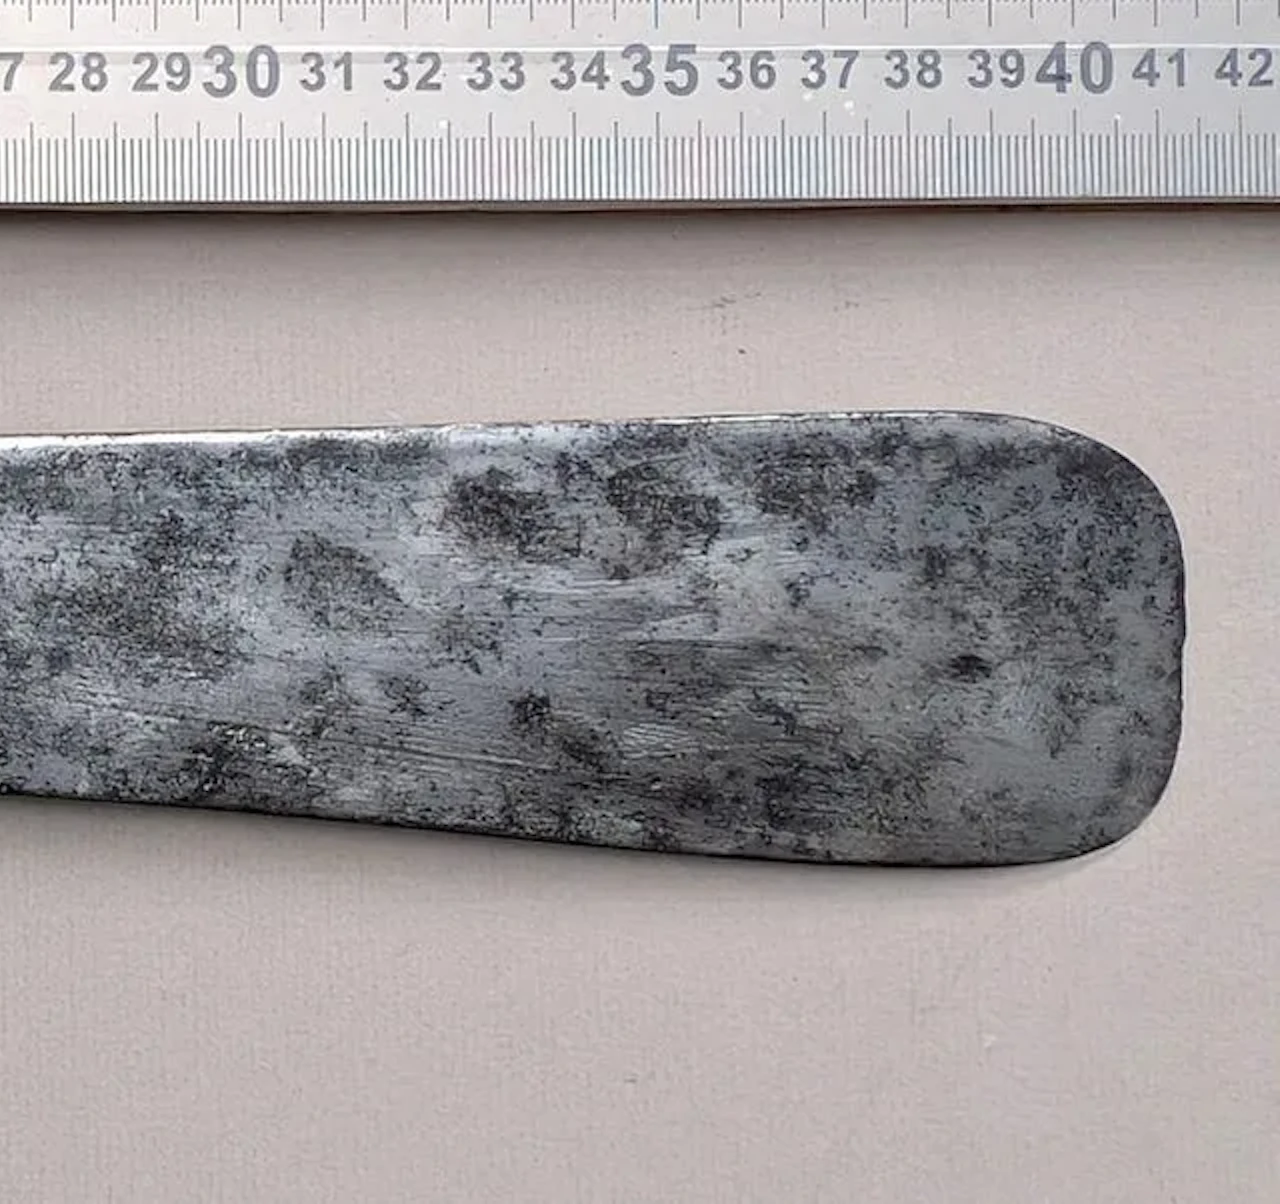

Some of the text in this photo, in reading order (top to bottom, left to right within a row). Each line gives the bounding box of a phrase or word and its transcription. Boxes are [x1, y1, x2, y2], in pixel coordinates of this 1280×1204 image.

[48, 51, 109, 93] 28
[131, 51, 192, 93] 29
[201, 43, 281, 99] 30
[295, 51, 354, 93] 31
[382, 51, 443, 92] 32
[465, 51, 526, 92] 33
[549, 50, 611, 92] 34
[619, 42, 699, 97] 35
[716, 49, 777, 91] 36
[800, 49, 861, 91] 37
[883, 48, 943, 91] 38
[966, 48, 1026, 89] 39
[1034, 40, 1114, 95] 40
[1131, 47, 1186, 88] 41
[1214, 47, 1275, 88] 42
